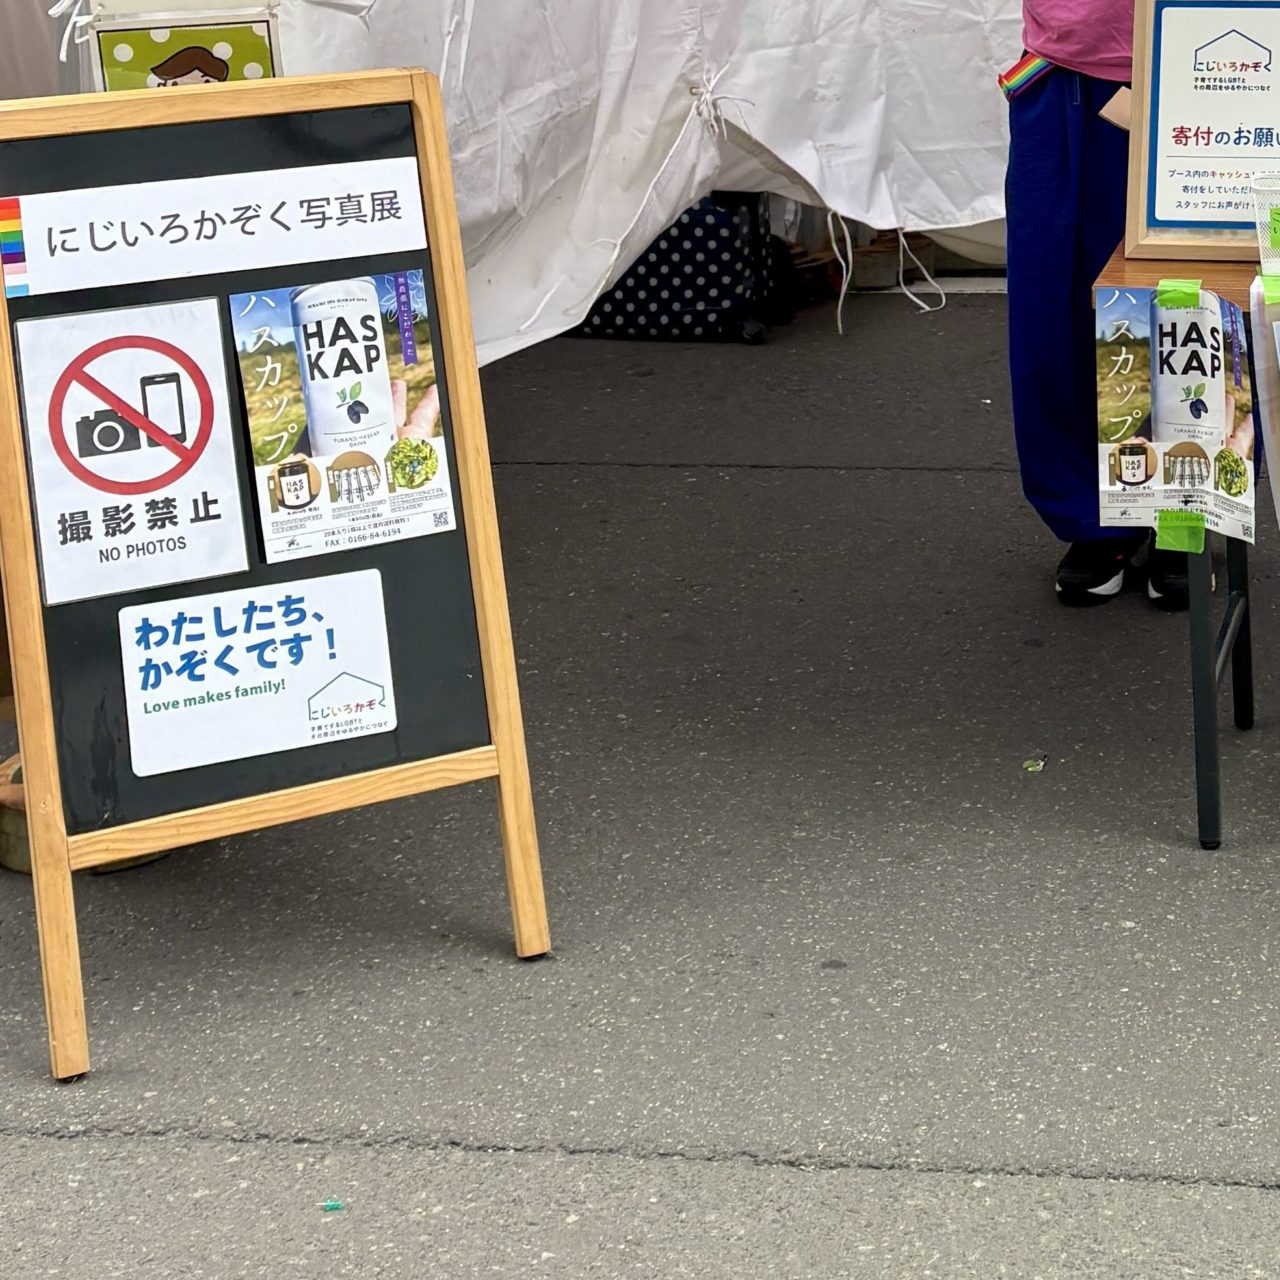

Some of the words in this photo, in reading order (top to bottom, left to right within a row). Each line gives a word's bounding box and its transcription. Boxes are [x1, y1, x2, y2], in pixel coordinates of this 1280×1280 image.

[1182, 185, 1253, 194] 寄付をしていただ
[47, 189, 402, 257] にじいろかぞく写真展
[302, 314, 378, 352] HAS
[1158, 321, 1221, 353] HAS
[239, 294, 298, 462] ハスカップ
[306, 344, 381, 381] KAP
[1103, 289, 1142, 442] ハスカップ
[1158, 348, 1222, 380] KAP
[57, 491, 222, 547] 撮影禁止
[99, 547, 121, 564] NO
[126, 535, 187, 559] PHOTOS
[135, 595, 325, 651] わたしたち、
[139, 628, 337, 692] かぞくです！
[143, 696, 180, 715] Love
[183, 688, 232, 709] makes
[235, 678, 287, 701] family!
